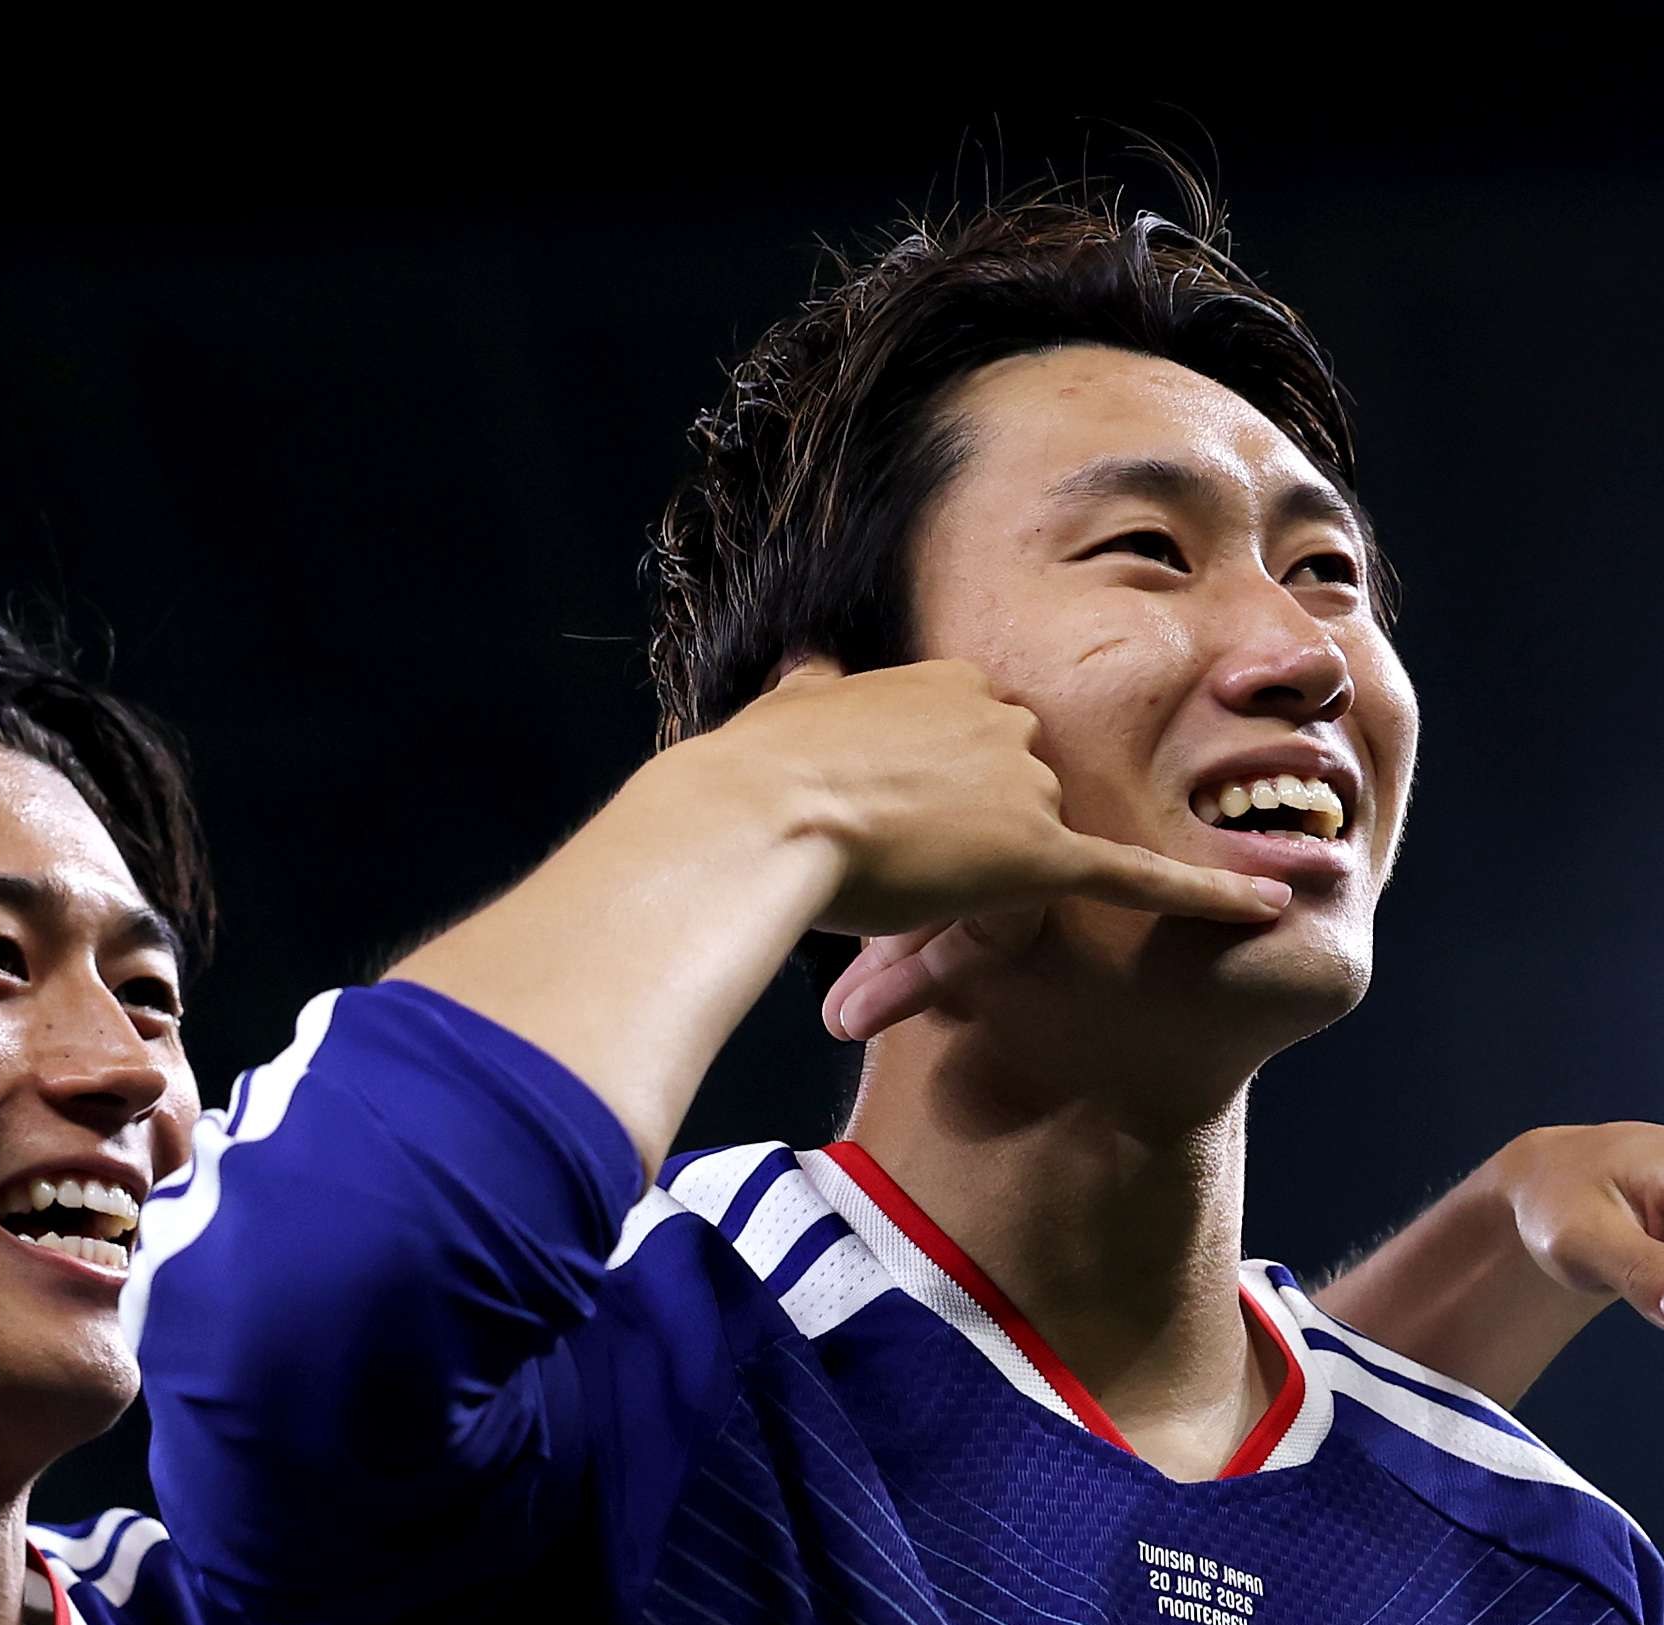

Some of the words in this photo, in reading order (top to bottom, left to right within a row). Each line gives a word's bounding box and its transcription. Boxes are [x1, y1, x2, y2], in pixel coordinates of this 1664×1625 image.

[1137, 1540, 1195, 1573] TUNISIA
[1222, 1565, 1264, 1596] JAPAN
[1149, 1570, 1170, 1591] 20
[1176, 1575, 1212, 1601] JUNE
[1216, 1587, 1253, 1615] 2026
